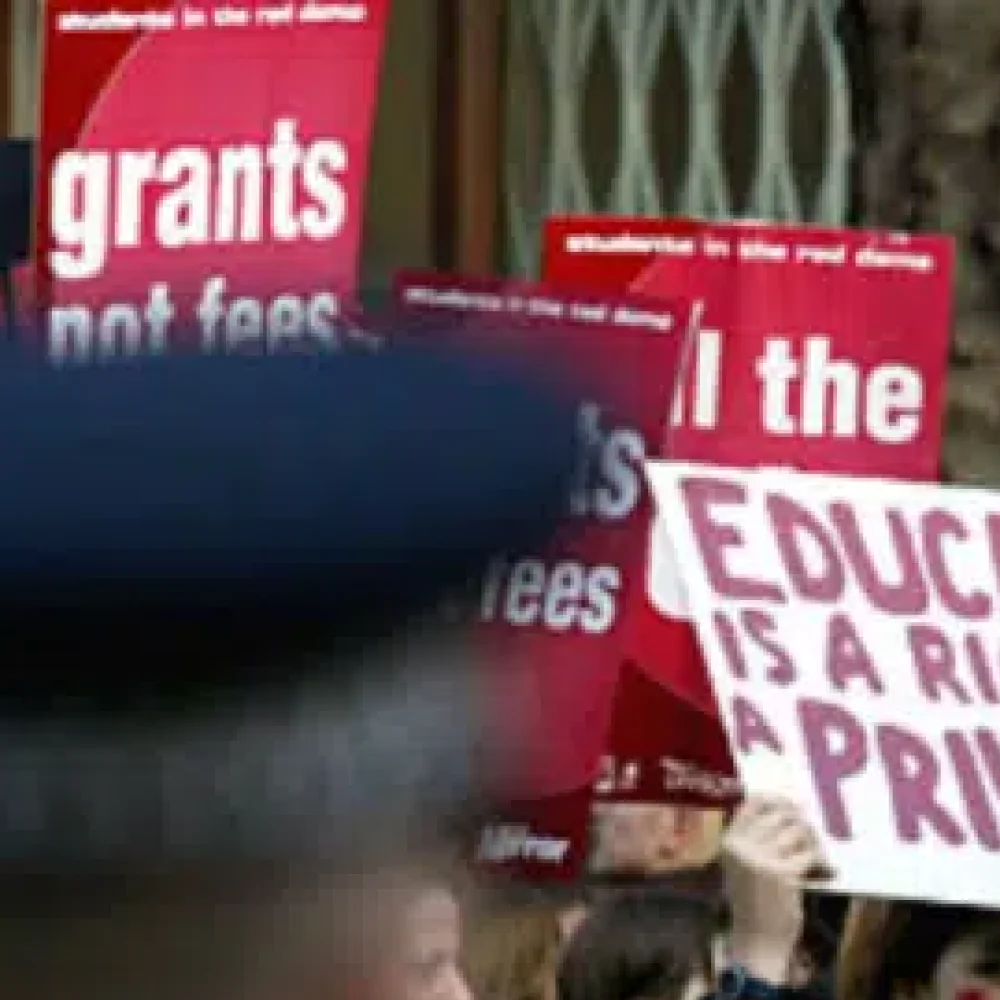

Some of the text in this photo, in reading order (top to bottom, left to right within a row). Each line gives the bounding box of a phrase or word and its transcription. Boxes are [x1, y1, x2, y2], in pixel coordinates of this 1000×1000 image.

[50, 118, 349, 281] grants
[757, 335, 925, 444] the
[711, 609, 799, 686] IS
[825, 614, 884, 694] A
[731, 696, 784, 755] A
